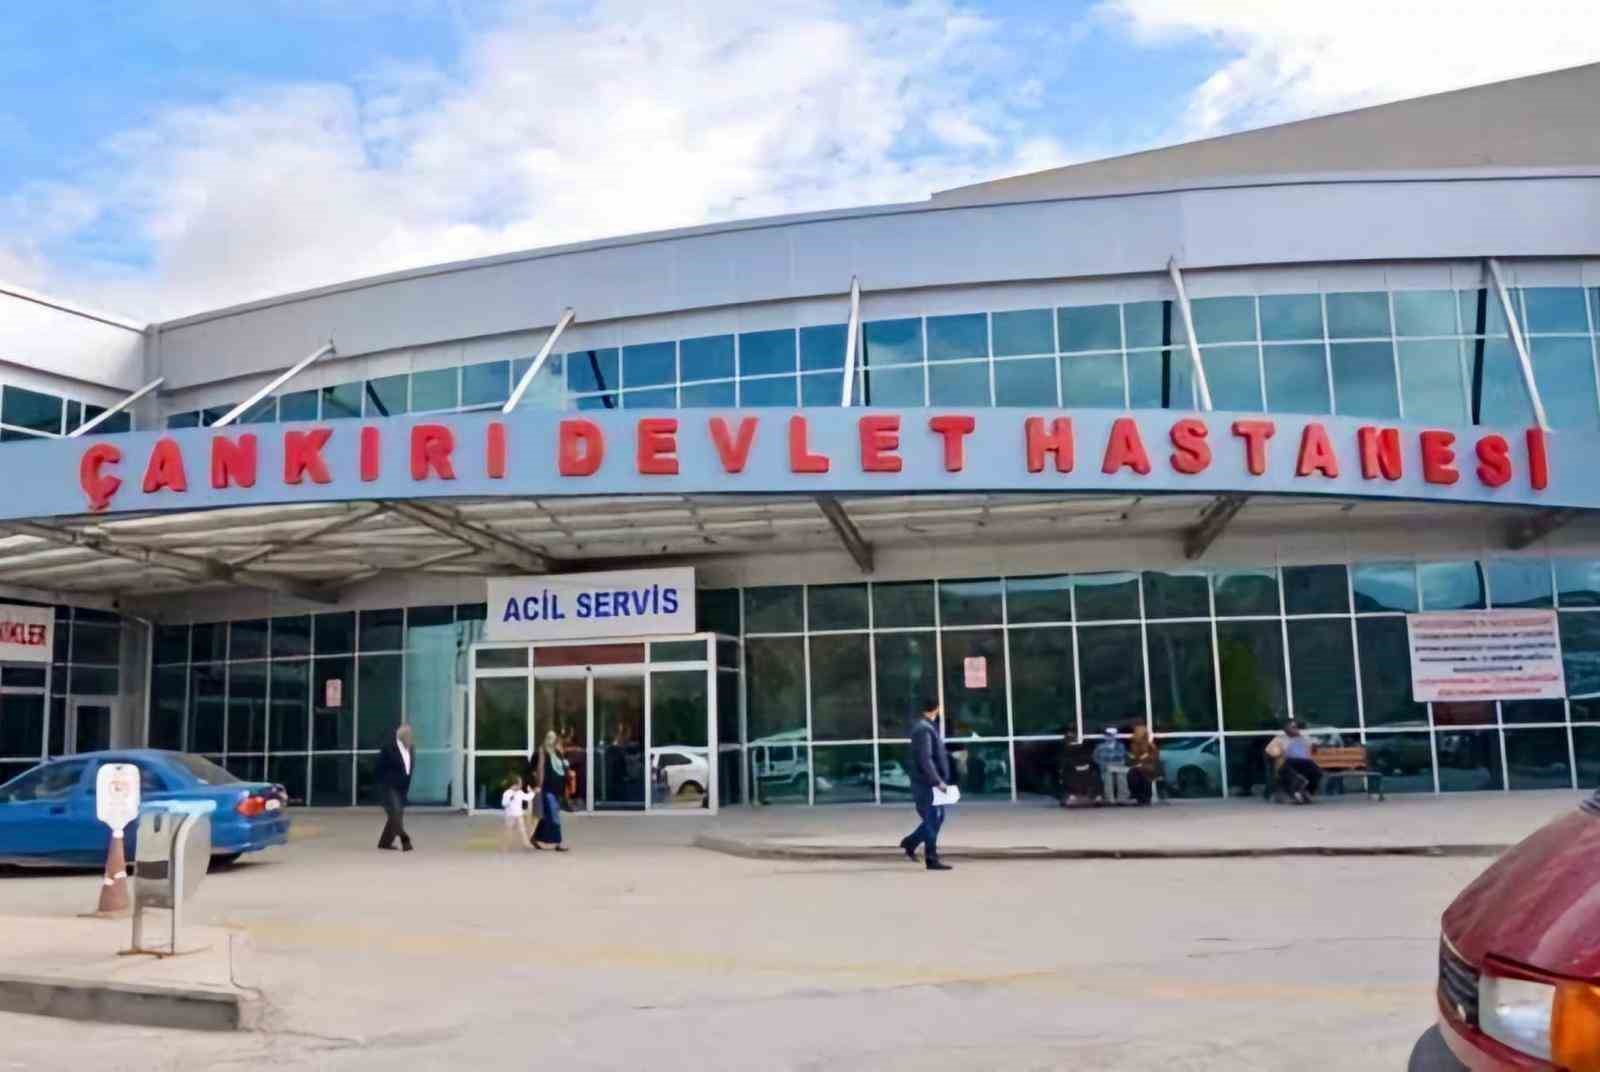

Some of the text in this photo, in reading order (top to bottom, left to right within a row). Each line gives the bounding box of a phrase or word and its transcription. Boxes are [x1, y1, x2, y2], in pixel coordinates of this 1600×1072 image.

[79, 421, 508, 511] ÇANKIRI
[558, 415, 977, 477] DEVLET
[502, 584, 680, 622] ACİL SERVİS
